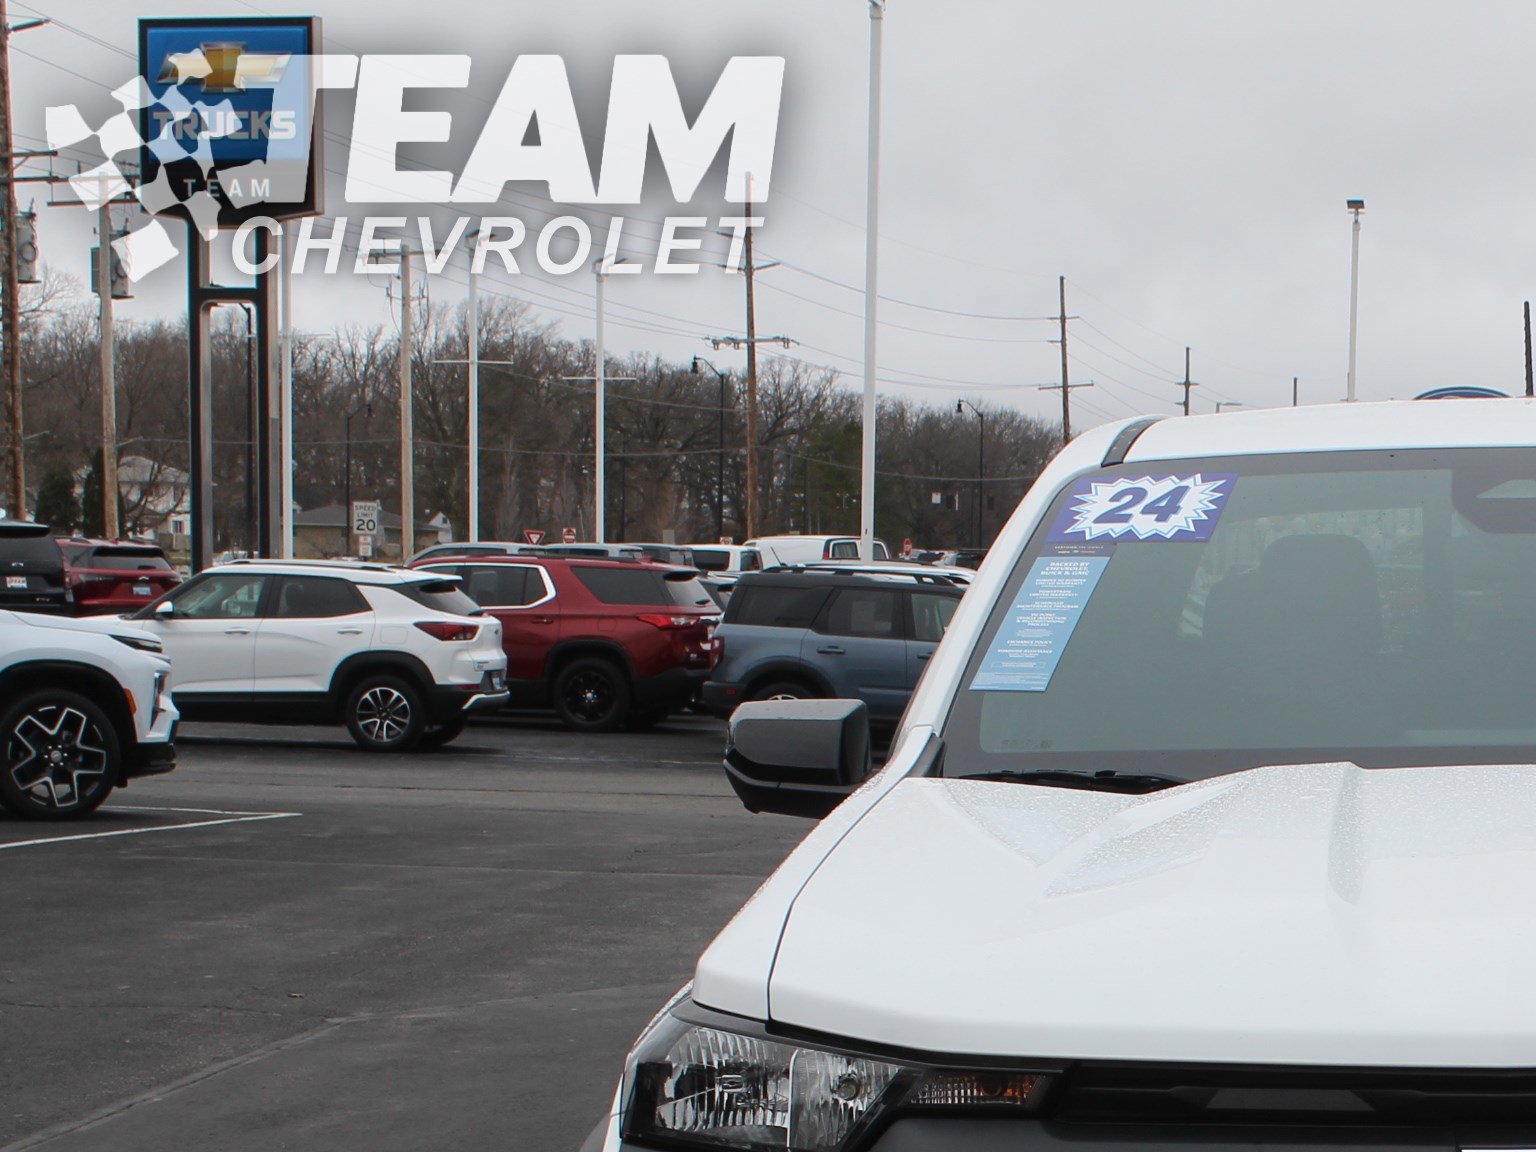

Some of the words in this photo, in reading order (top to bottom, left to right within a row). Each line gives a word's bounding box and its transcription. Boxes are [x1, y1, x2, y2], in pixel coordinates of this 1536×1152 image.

[153, 111, 297, 141] TRUCKS
[183, 178, 271, 198] TEAM
[1092, 485, 1191, 524] 24
[356, 518, 376, 531] 20
